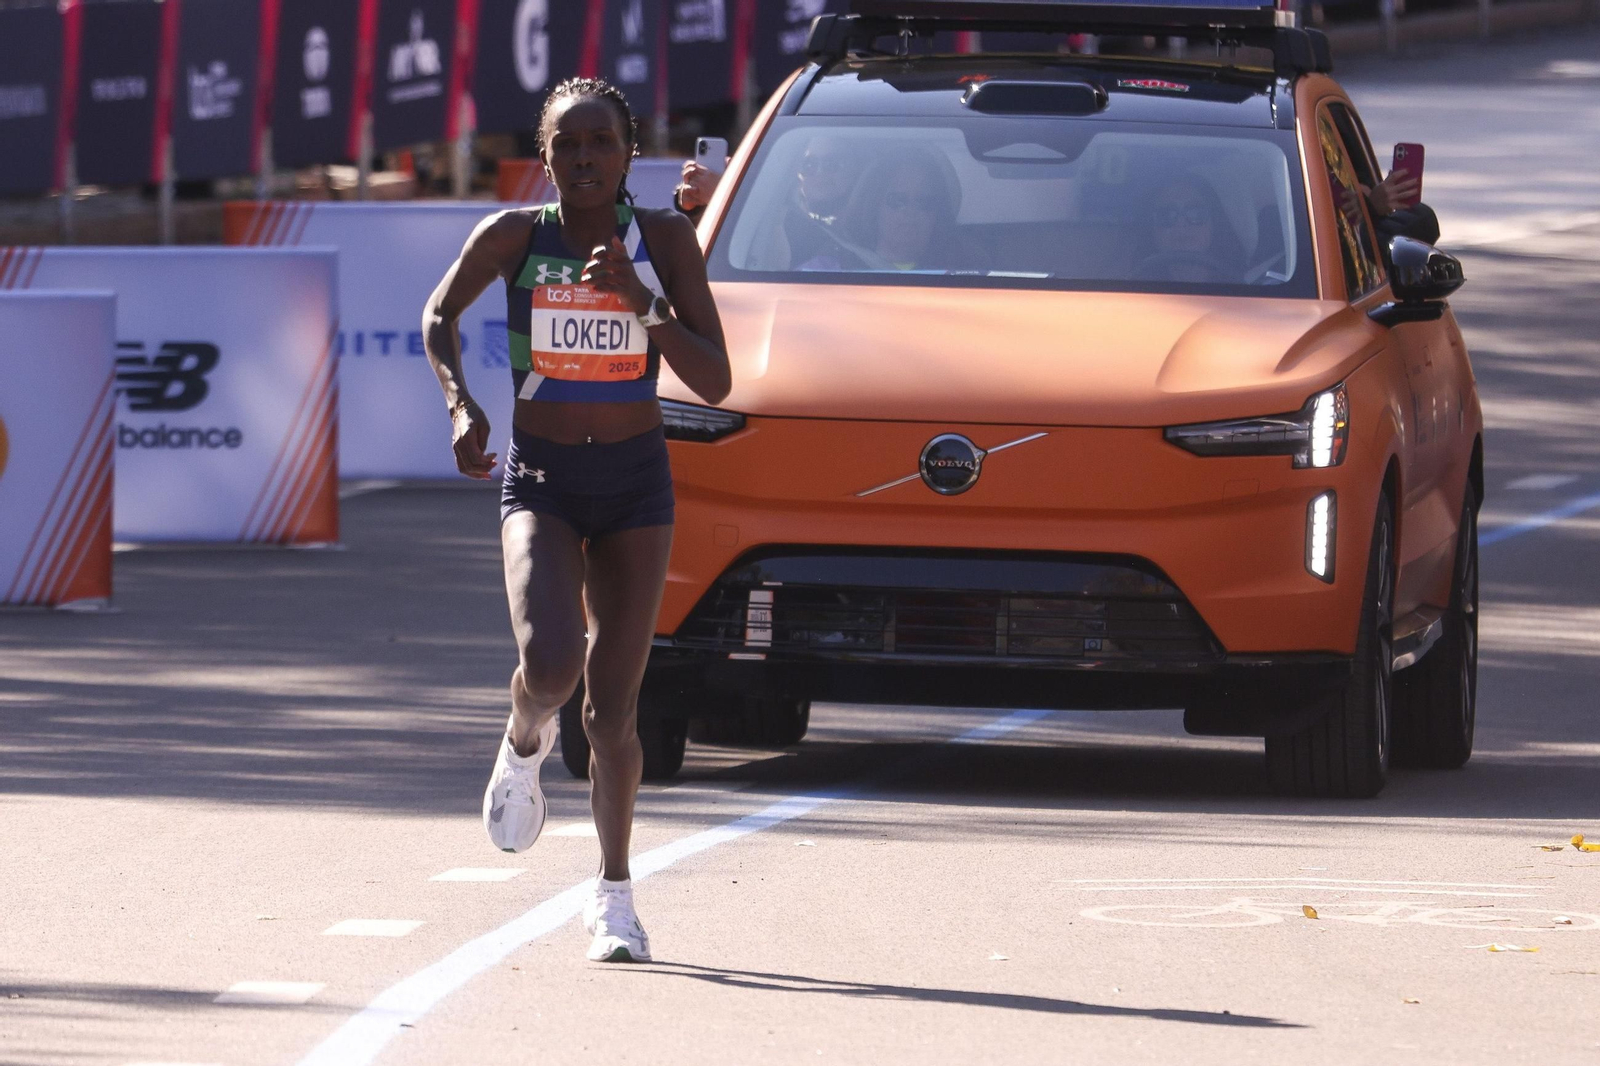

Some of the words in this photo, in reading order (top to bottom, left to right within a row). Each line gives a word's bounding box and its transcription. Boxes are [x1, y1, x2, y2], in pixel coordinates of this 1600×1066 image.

[547, 287, 572, 302] tcs
[551, 317, 630, 350] LOKEDI
[609, 362, 639, 373] 2025
[118, 424, 242, 449] balance
[929, 460, 975, 470] VOLVO
